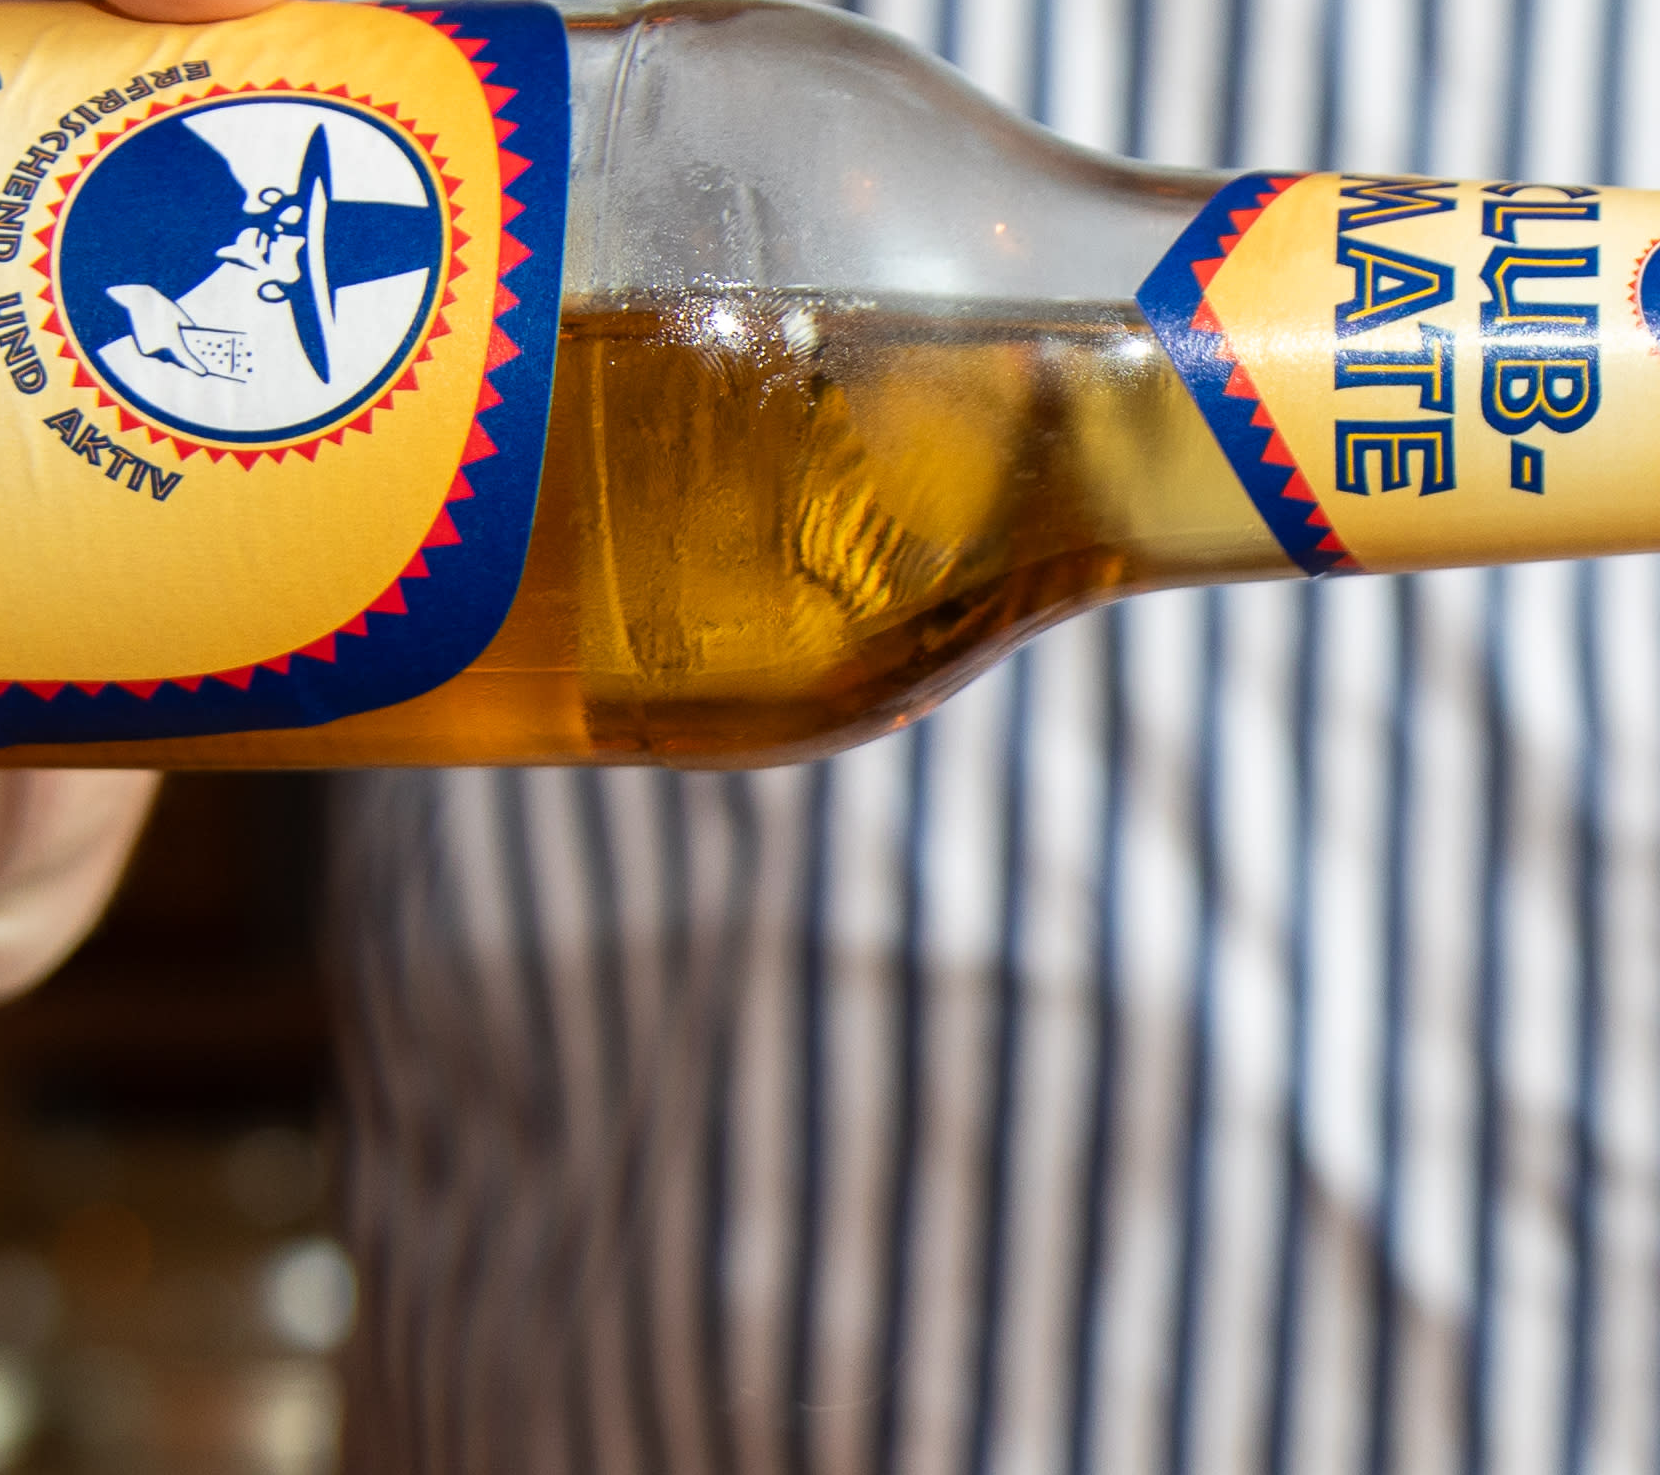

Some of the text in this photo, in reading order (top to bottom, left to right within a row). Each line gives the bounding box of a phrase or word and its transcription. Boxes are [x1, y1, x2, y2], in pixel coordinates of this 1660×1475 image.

[43, 406, 183, 502] AKTIV
[1334, 174, 1459, 497] MATE
[1479, 182, 1602, 496] CLUB-
